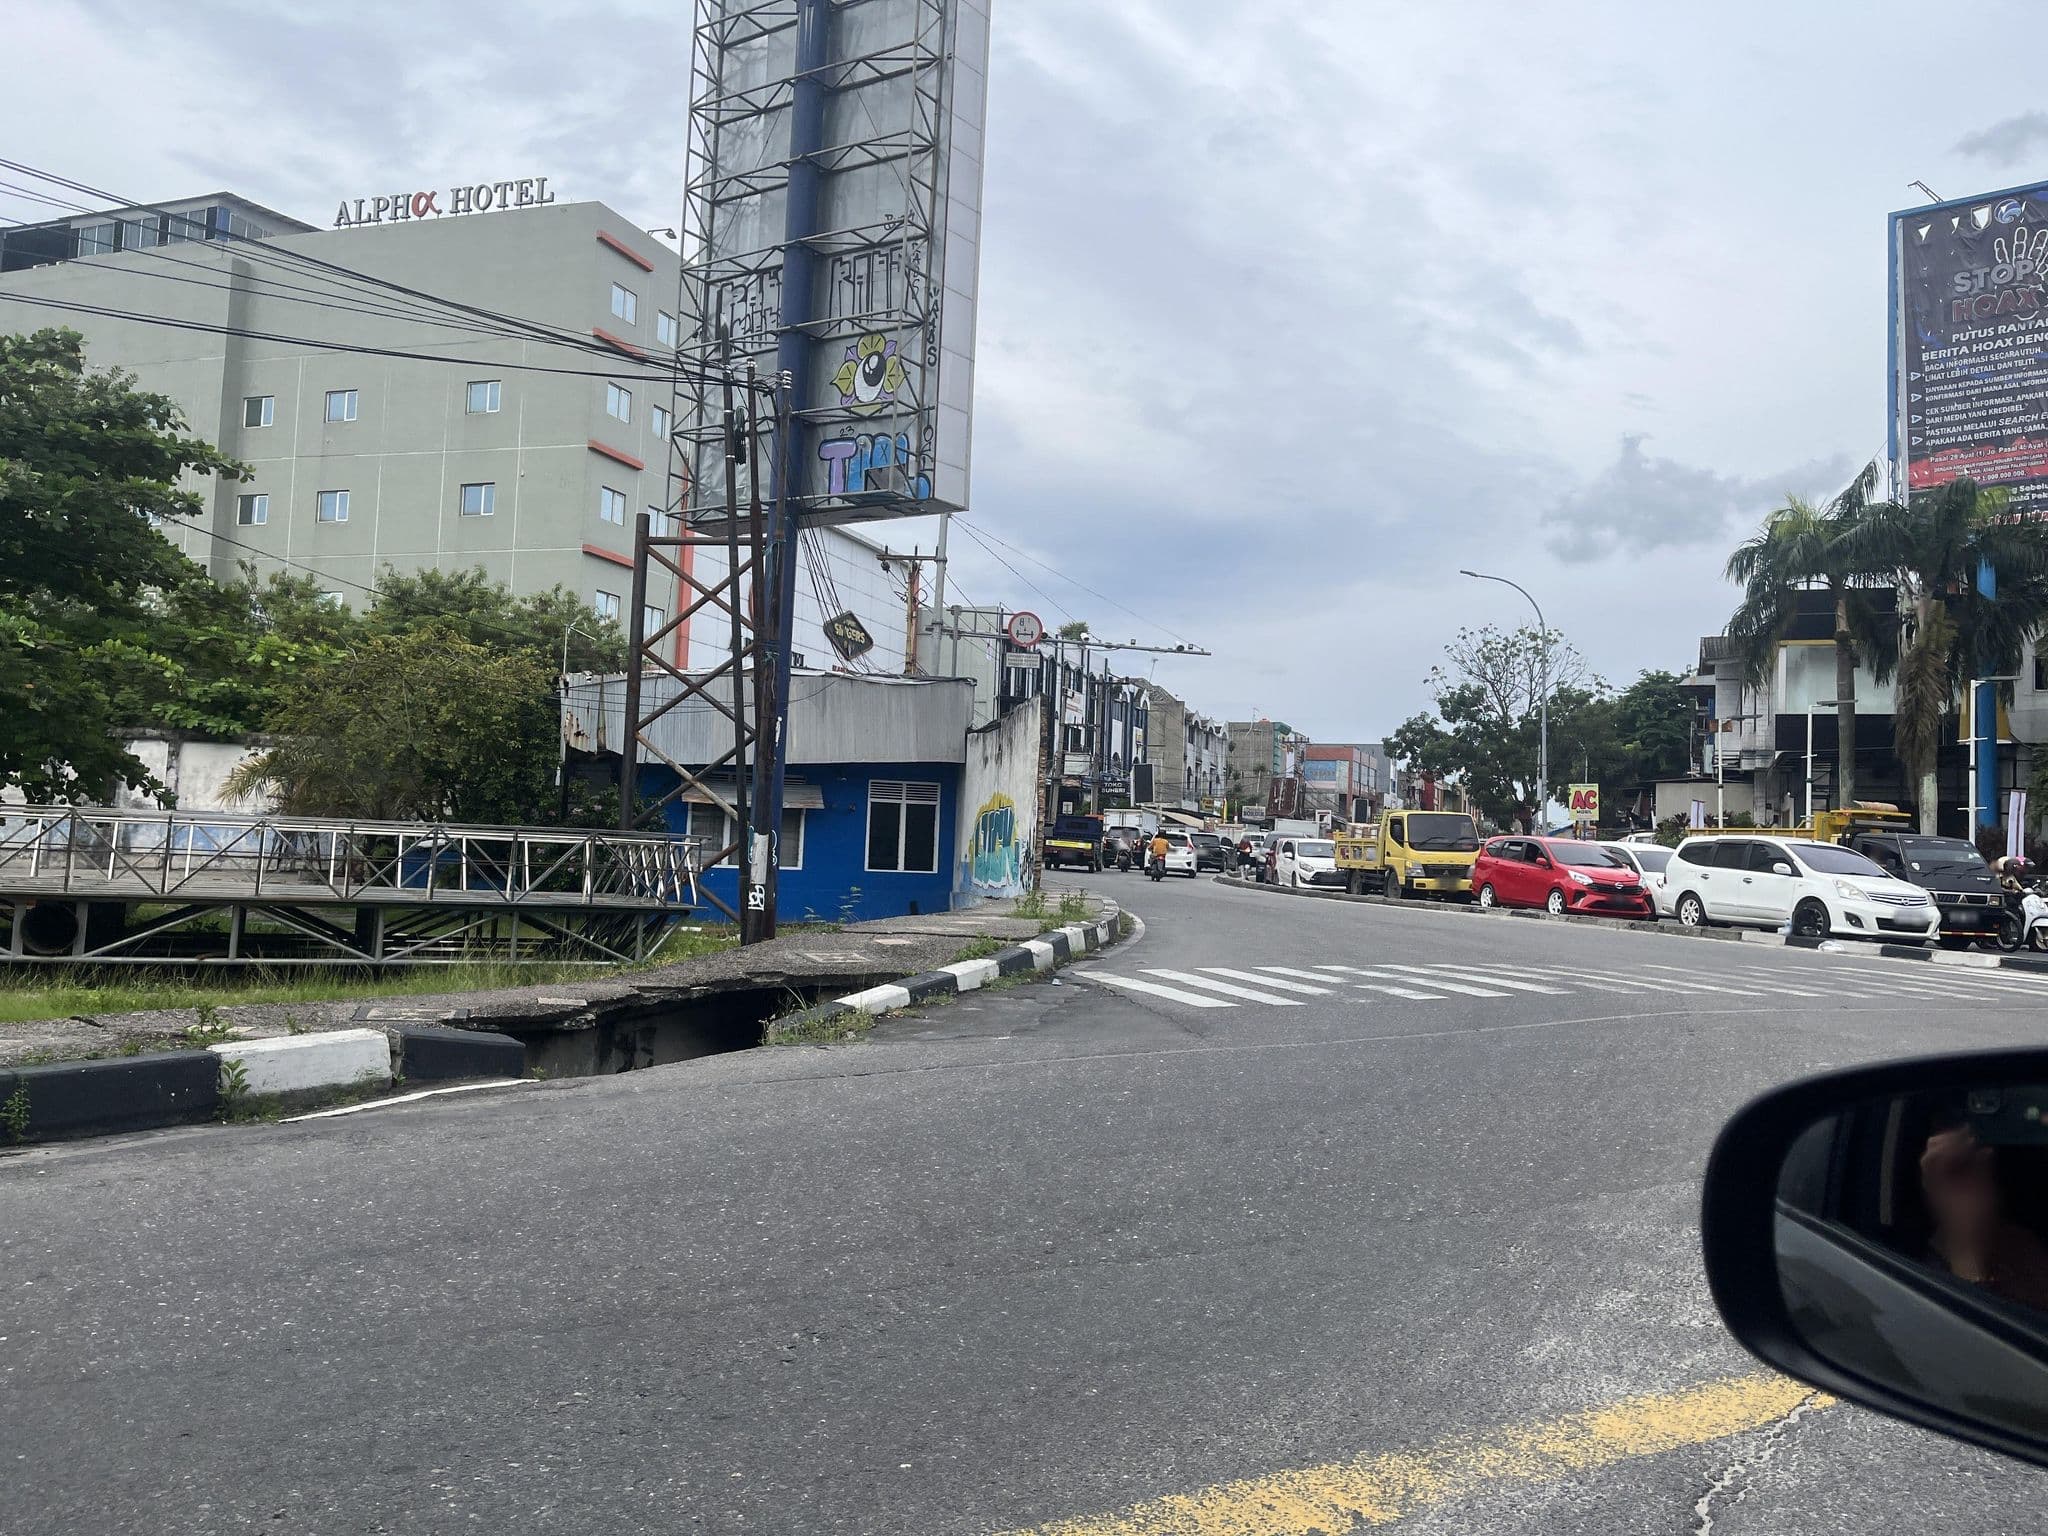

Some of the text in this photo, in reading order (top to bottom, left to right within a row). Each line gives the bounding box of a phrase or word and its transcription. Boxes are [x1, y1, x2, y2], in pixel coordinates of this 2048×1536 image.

[449, 177, 555, 213] HOTEL
[1953, 259, 2034, 292] STOP
[1952, 286, 2040, 322] HOAX
[1952, 327, 1995, 343] PUTUS
[1921, 346, 1970, 361] BERITA
[1972, 337, 2014, 353] HOAX
[1924, 362, 1945, 373] BACA
[1946, 355, 1989, 369] INFORMASI
[1924, 372, 1946, 383] LIHAT
[1946, 368, 1969, 379] LEBIH
[1970, 364, 1997, 375] DETAIL
[1996, 359, 2013, 370] DAN
[1958, 377, 1985, 389] KEPADA
[1984, 373, 2013, 384] SUMBER
[1966, 387, 1982, 397] DARI
[1982, 384, 2003, 393] MANA
[2003, 381, 2020, 390] ASAL
[1925, 408, 1940, 416] CEK
[1940, 401, 1972, 414] SUMBER
[2016, 391, 2045, 401] APAKAH
[1925, 415, 1943, 425] DARI
[1943, 412, 1967, 423] MEDIA
[1967, 409, 1987, 419] YANG
[1925, 425, 1962, 437] PASTIKAN
[1963, 420, 1997, 432] MELALUI
[1998, 412, 2039, 427] SEARCH
[1925, 436, 1956, 447] APAKAH
[1957, 434, 1973, 443] ADA
[1973, 429, 2001, 441] BERITA
[2001, 425, 2023, 436] YANG
[1998, 446, 2018, 454] Pasal
[2028, 441, 2044, 450] Ayat
[1571, 790, 1598, 810] AC
